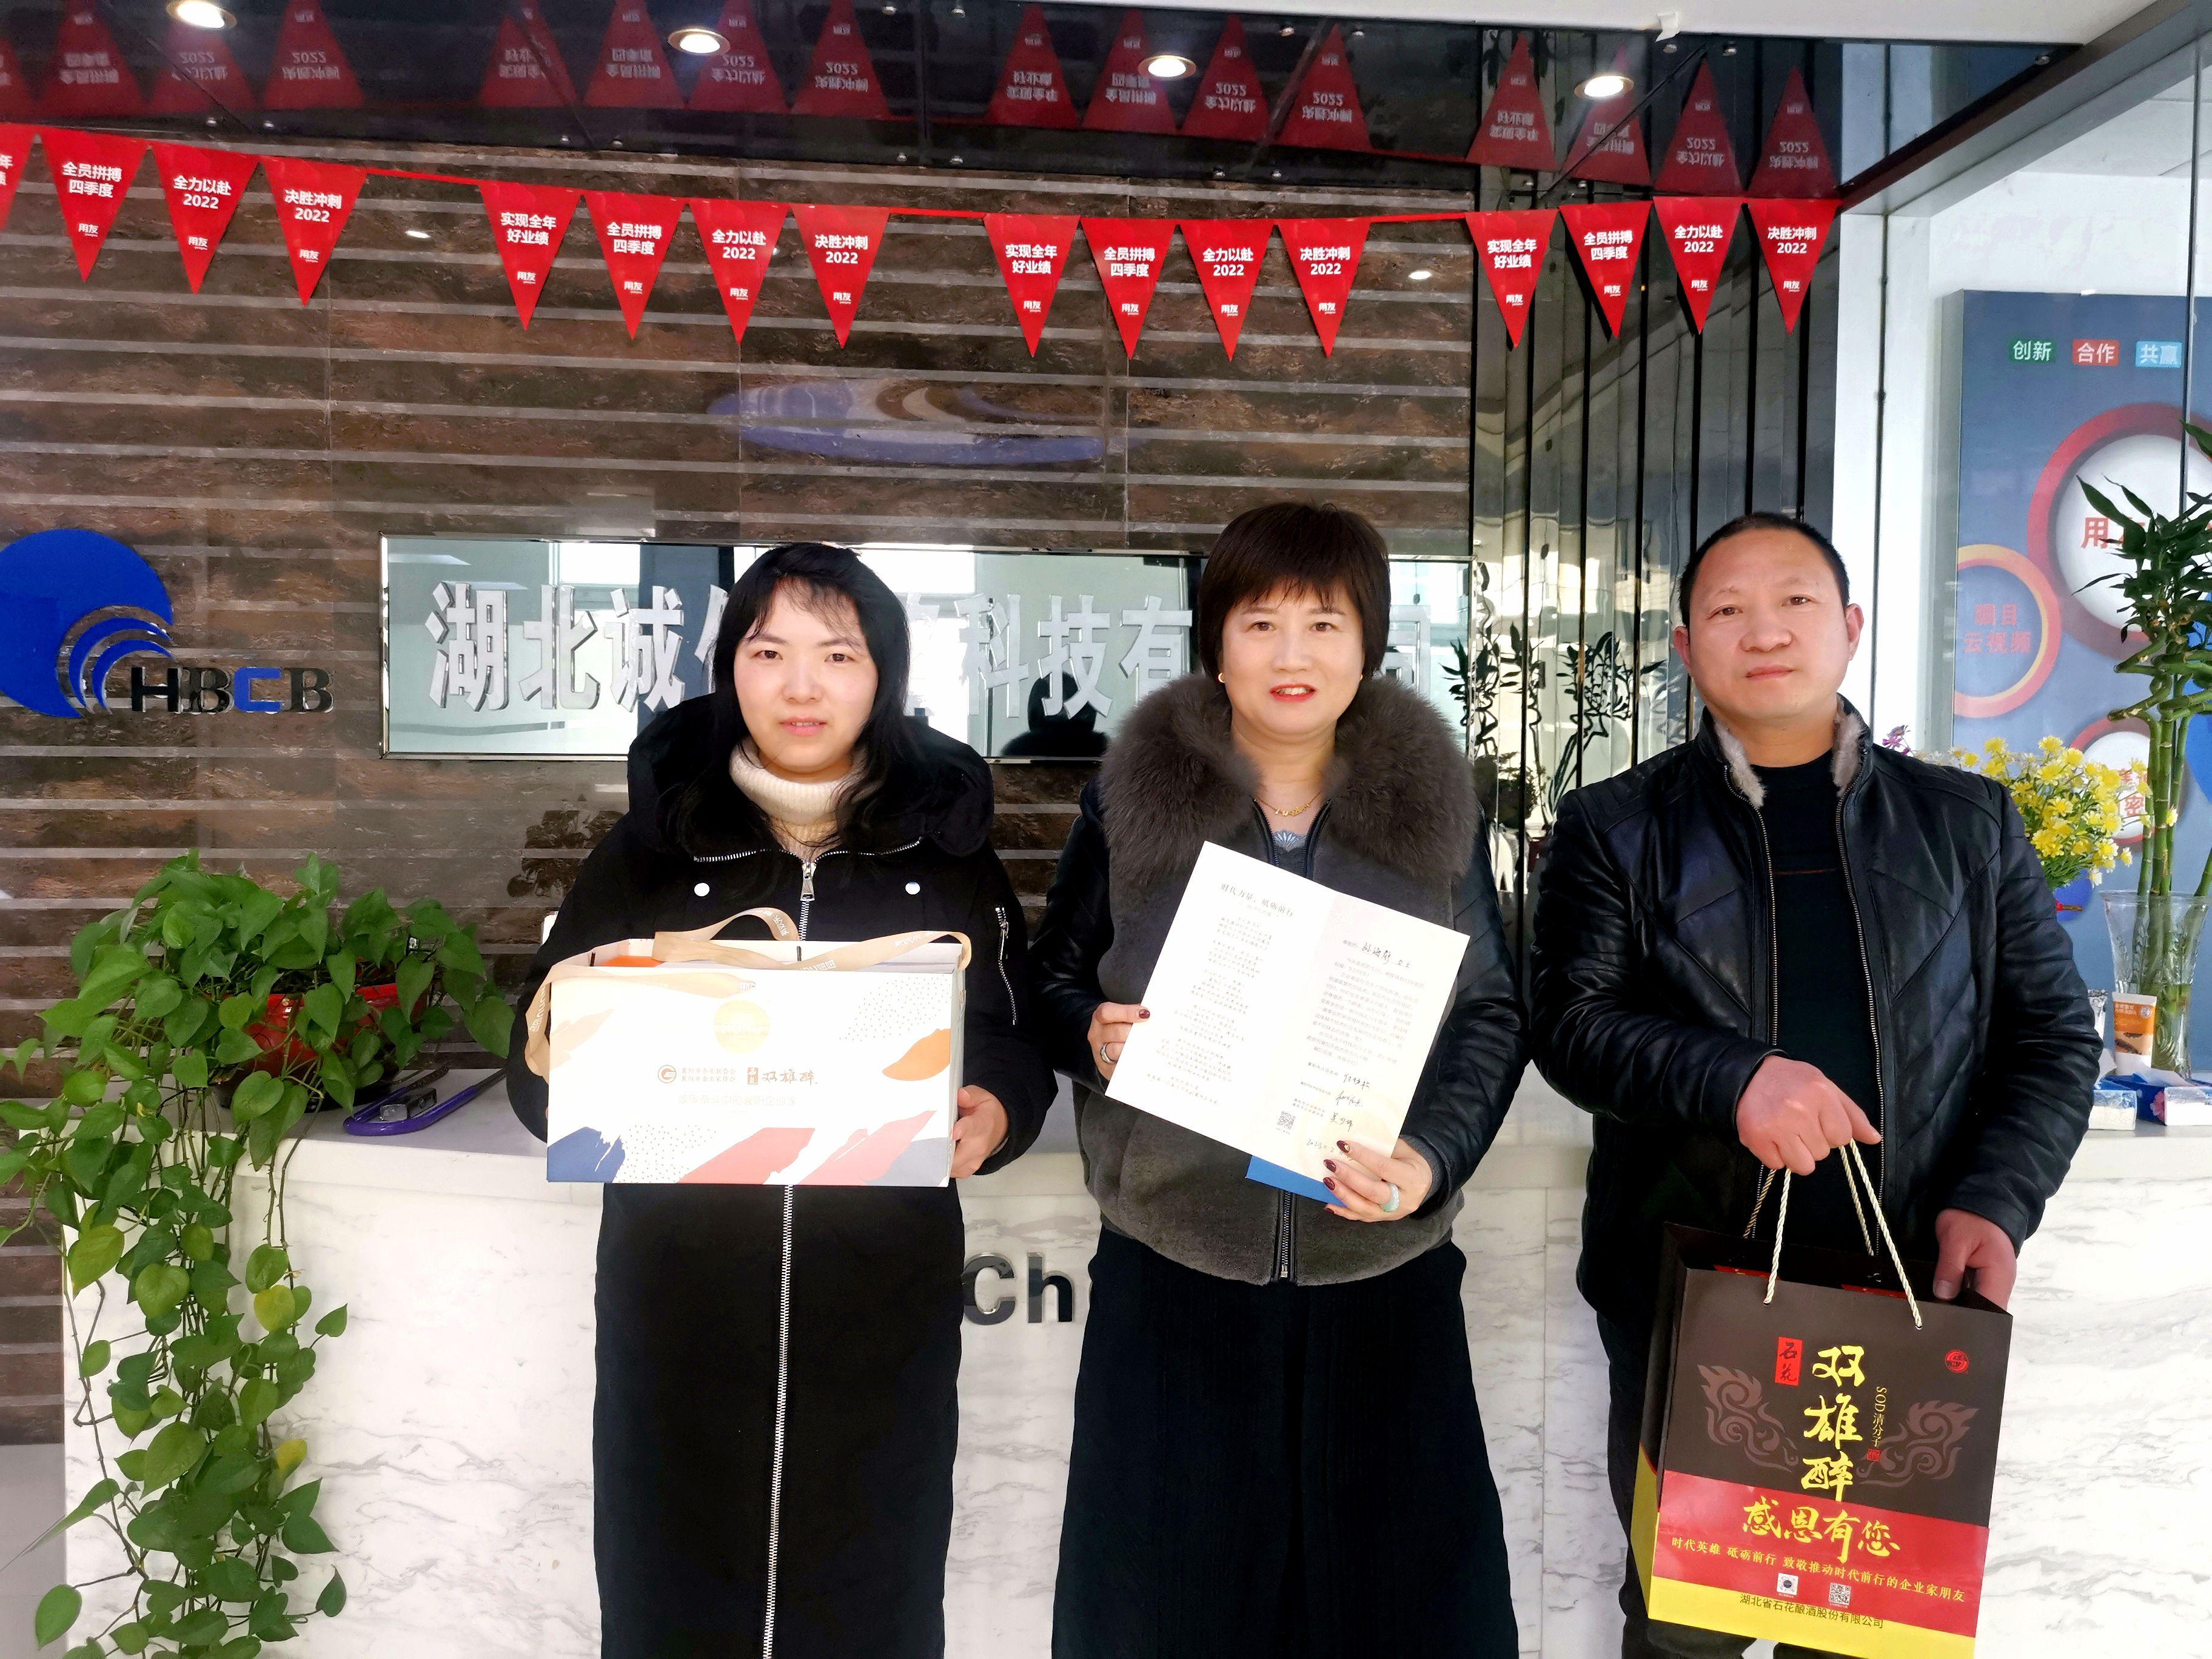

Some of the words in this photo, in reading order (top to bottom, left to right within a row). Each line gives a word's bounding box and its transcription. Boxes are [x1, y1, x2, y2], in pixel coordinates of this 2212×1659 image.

[62, 163, 122, 182] 全员拼搏
[70, 179, 113, 198] 四季度
[173, 175, 231, 195] 全力以赴
[183, 193, 218, 209] 2022
[285, 190, 341, 209] 决胜冲刺
[295, 207, 329, 222] 2022
[501, 212, 556, 229] 实现全年
[79, 223, 98, 234] 用友
[607, 222, 662, 239] 全员拼搏
[1675, 225, 1723, 238] 全力以赴
[1768, 227, 1817, 240] 决胜冲刺
[189, 236, 207, 247] 用友
[508, 229, 549, 245] 好业绩
[712, 229, 766, 245] 全力以赴
[815, 235, 868, 250] 决胜冲刺
[1584, 230, 1633, 245] 全员拼搏
[614, 240, 654, 255] 四季度
[1005, 244, 1057, 258] 实现全年
[1487, 239, 1537, 253] 实现全年
[1684, 241, 1714, 252] 2022
[1777, 243, 1807, 253] 2022
[300, 250, 319, 261] 用友
[723, 247, 755, 260] 2022
[826, 251, 857, 264] 2022
[1104, 247, 1155, 261] 全员拼搏
[1203, 248, 1253, 261] 全力以赴
[1300, 247, 1350, 261] 决胜冲刺
[1591, 246, 1627, 261] 四季度
[1012, 260, 1051, 274] 好业绩
[1494, 254, 1531, 269] 好业绩
[1111, 263, 1148, 276] 四季度
[1213, 264, 1244, 276] 2022
[1311, 263, 1341, 275] 2022
[517, 272, 535, 283] 用友
[625, 281, 642, 292] 用友
[1604, 286, 1621, 295] 用友
[1692, 280, 1708, 290] 用友
[1783, 281, 1800, 289] 用友
[730, 288, 748, 299] 用友
[834, 292, 851, 303] 用友
[1506, 294, 1523, 304] 用友
[1024, 301, 1041, 311] 用友
[1122, 304, 1138, 313] 用友
[1221, 304, 1238, 313] 用友
[1319, 303, 1335, 312] 用友
[2013, 340, 2054, 362] 创新
[2077, 343, 2115, 364] 合作
[131, 666, 334, 714] HBCB
[762, 1068, 814, 1085] 双雄醉
[960, 1252, 1090, 1326] Ch
[1779, 1341, 1797, 1382] 石花
[1801, 1345, 1866, 1502] 双雄醉
[1742, 1495, 1900, 1564] 感恩有您
[1671, 1537, 1721, 1556] 时代英雄
[1727, 1546, 1777, 1566] 砥砺前行
[1783, 1555, 1966, 1604] 致敬推动时代前行的企业家朋友
[1739, 1593, 1884, 1629] 湖北省石花酿酒股份有限公司
